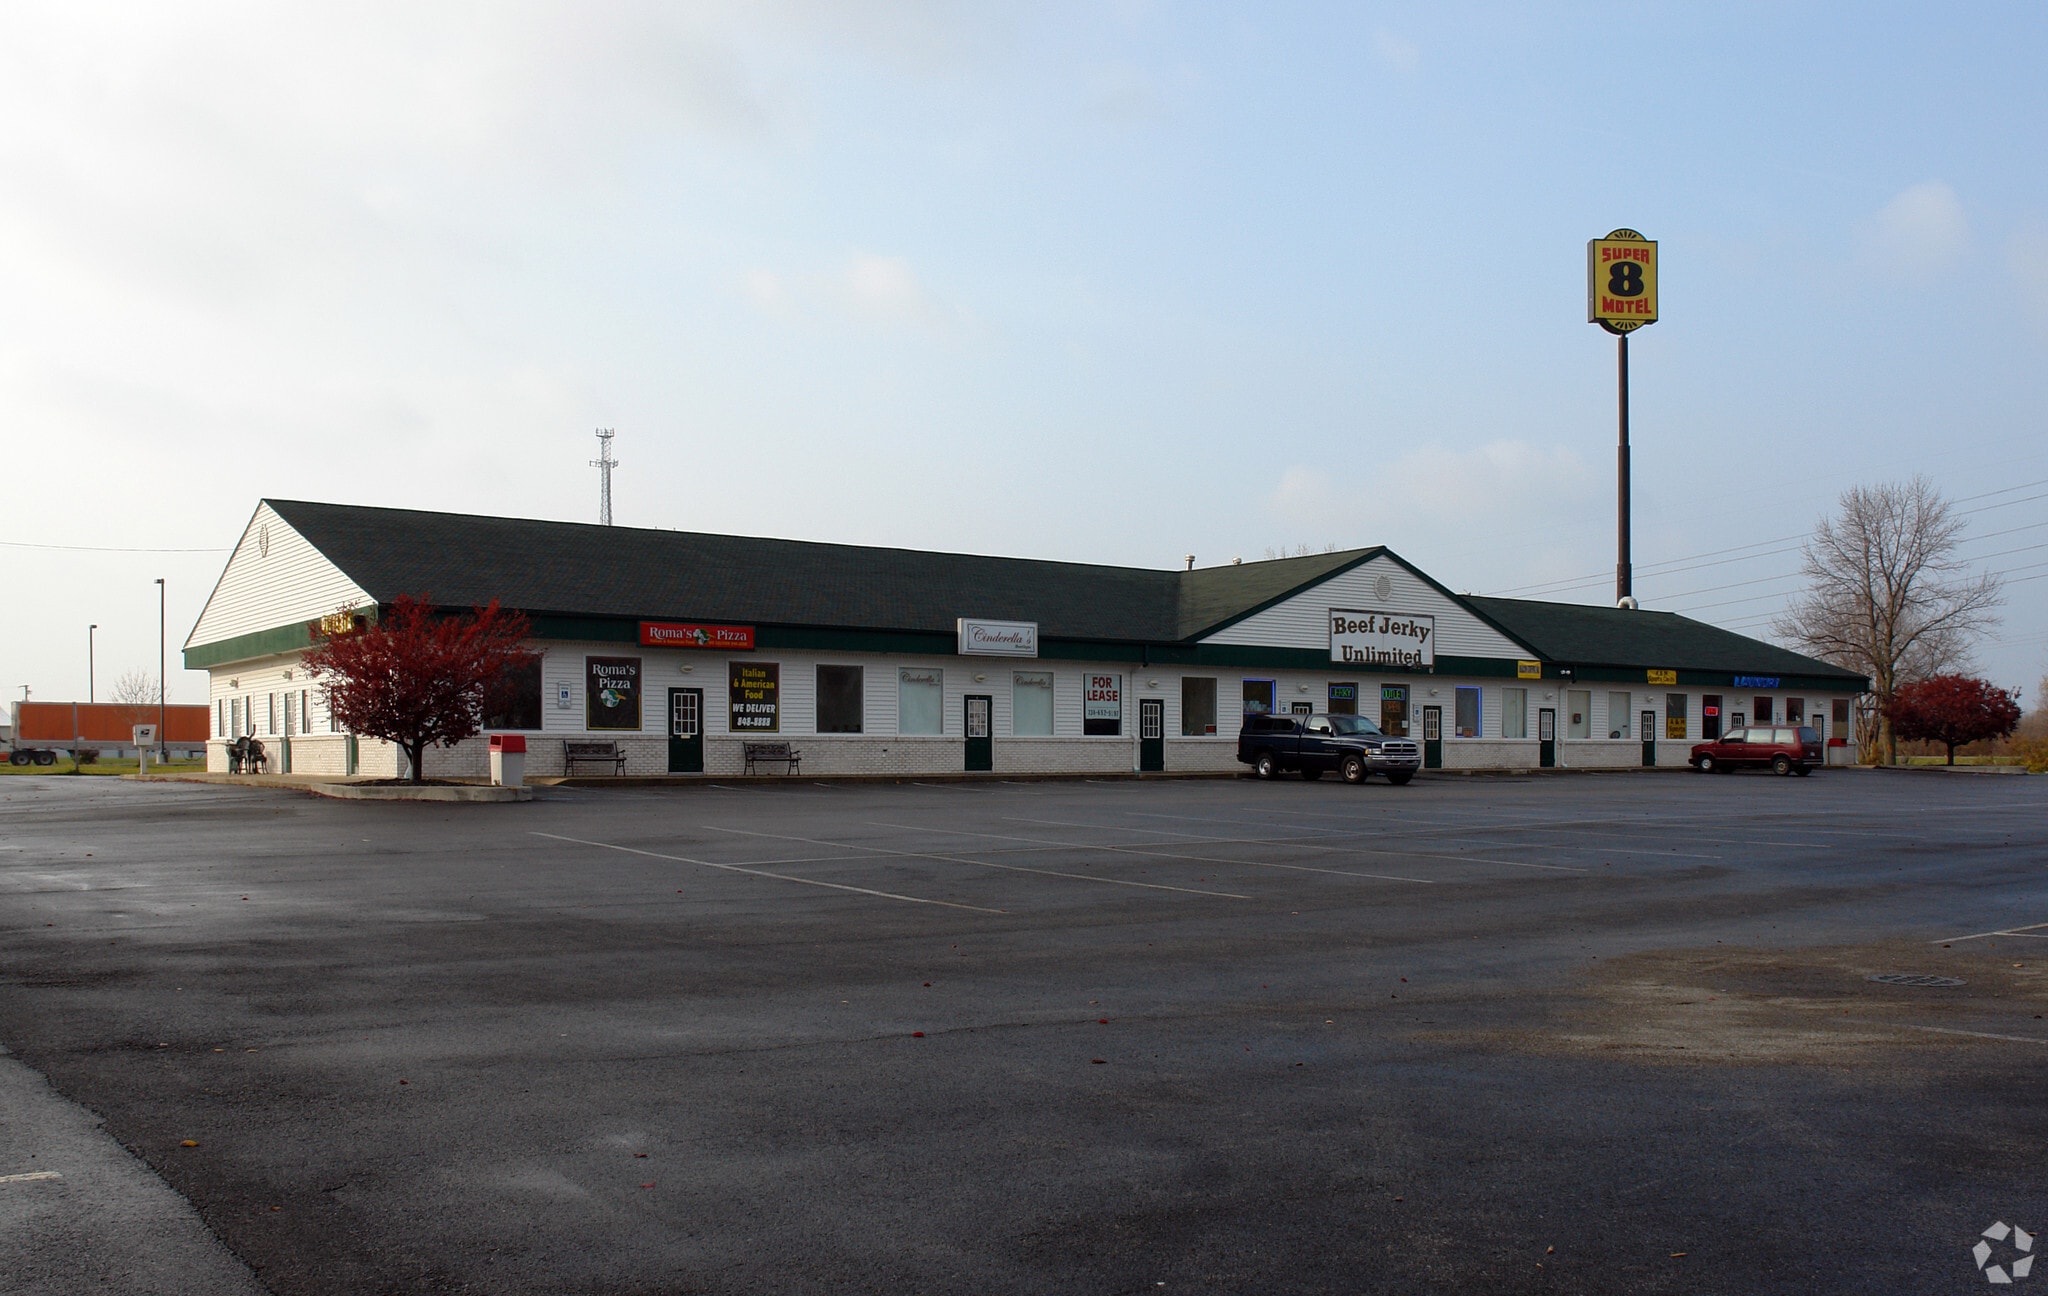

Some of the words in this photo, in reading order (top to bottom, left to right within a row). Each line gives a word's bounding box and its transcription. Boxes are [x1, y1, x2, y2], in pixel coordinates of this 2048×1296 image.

[1602, 247, 1650, 265] SUPER
[1608, 261, 1645, 297] 8
[1602, 295, 1652, 314] MOTEL
[649, 627, 693, 640] Roma's
[717, 630, 747, 641] Pizza
[1333, 615, 1376, 634] Beef
[1379, 617, 1431, 644] Jerky
[1342, 645, 1422, 666] Unlimited
[592, 664, 636, 677] Roma's
[742, 668, 766, 678] Italian
[599, 677, 631, 689] Pizza
[741, 679, 775, 689] American
[1092, 676, 1112, 689] FOR
[745, 689, 764, 699] Food
[1087, 690, 1118, 702] LEASE
[732, 703, 744, 713] WE
[746, 703, 776, 714] DELIVER
